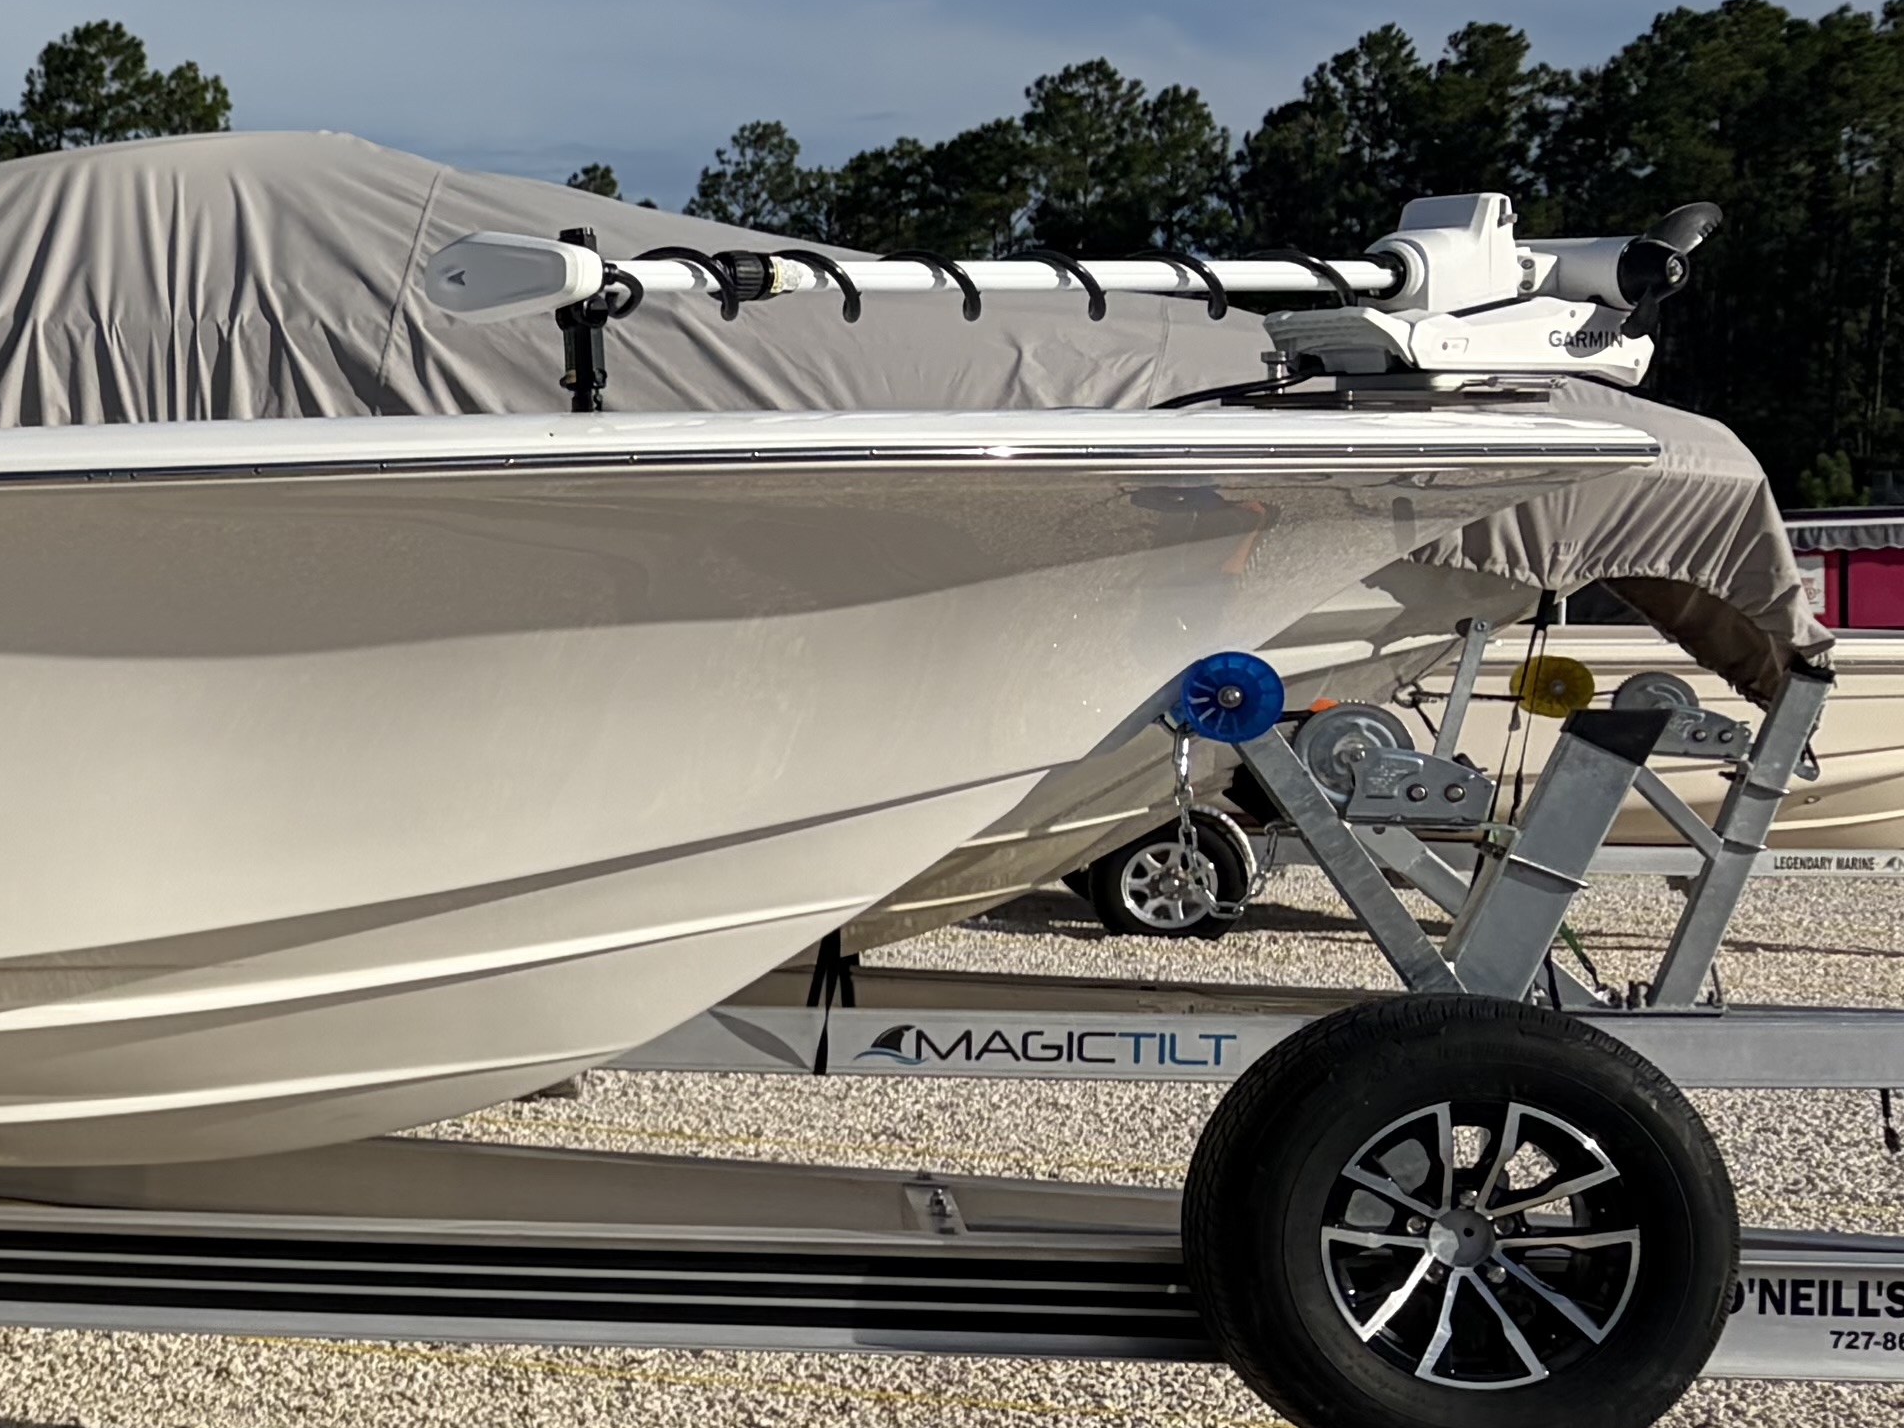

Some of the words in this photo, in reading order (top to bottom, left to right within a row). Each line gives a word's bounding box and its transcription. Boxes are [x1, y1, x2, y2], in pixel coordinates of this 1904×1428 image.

[1548, 330, 1623, 349] GARMIN
[1773, 856, 1833, 870] LEGENDARY
[1836, 856, 1875, 871] MARINE
[915, 1029, 1237, 1066] MAGICTILT
